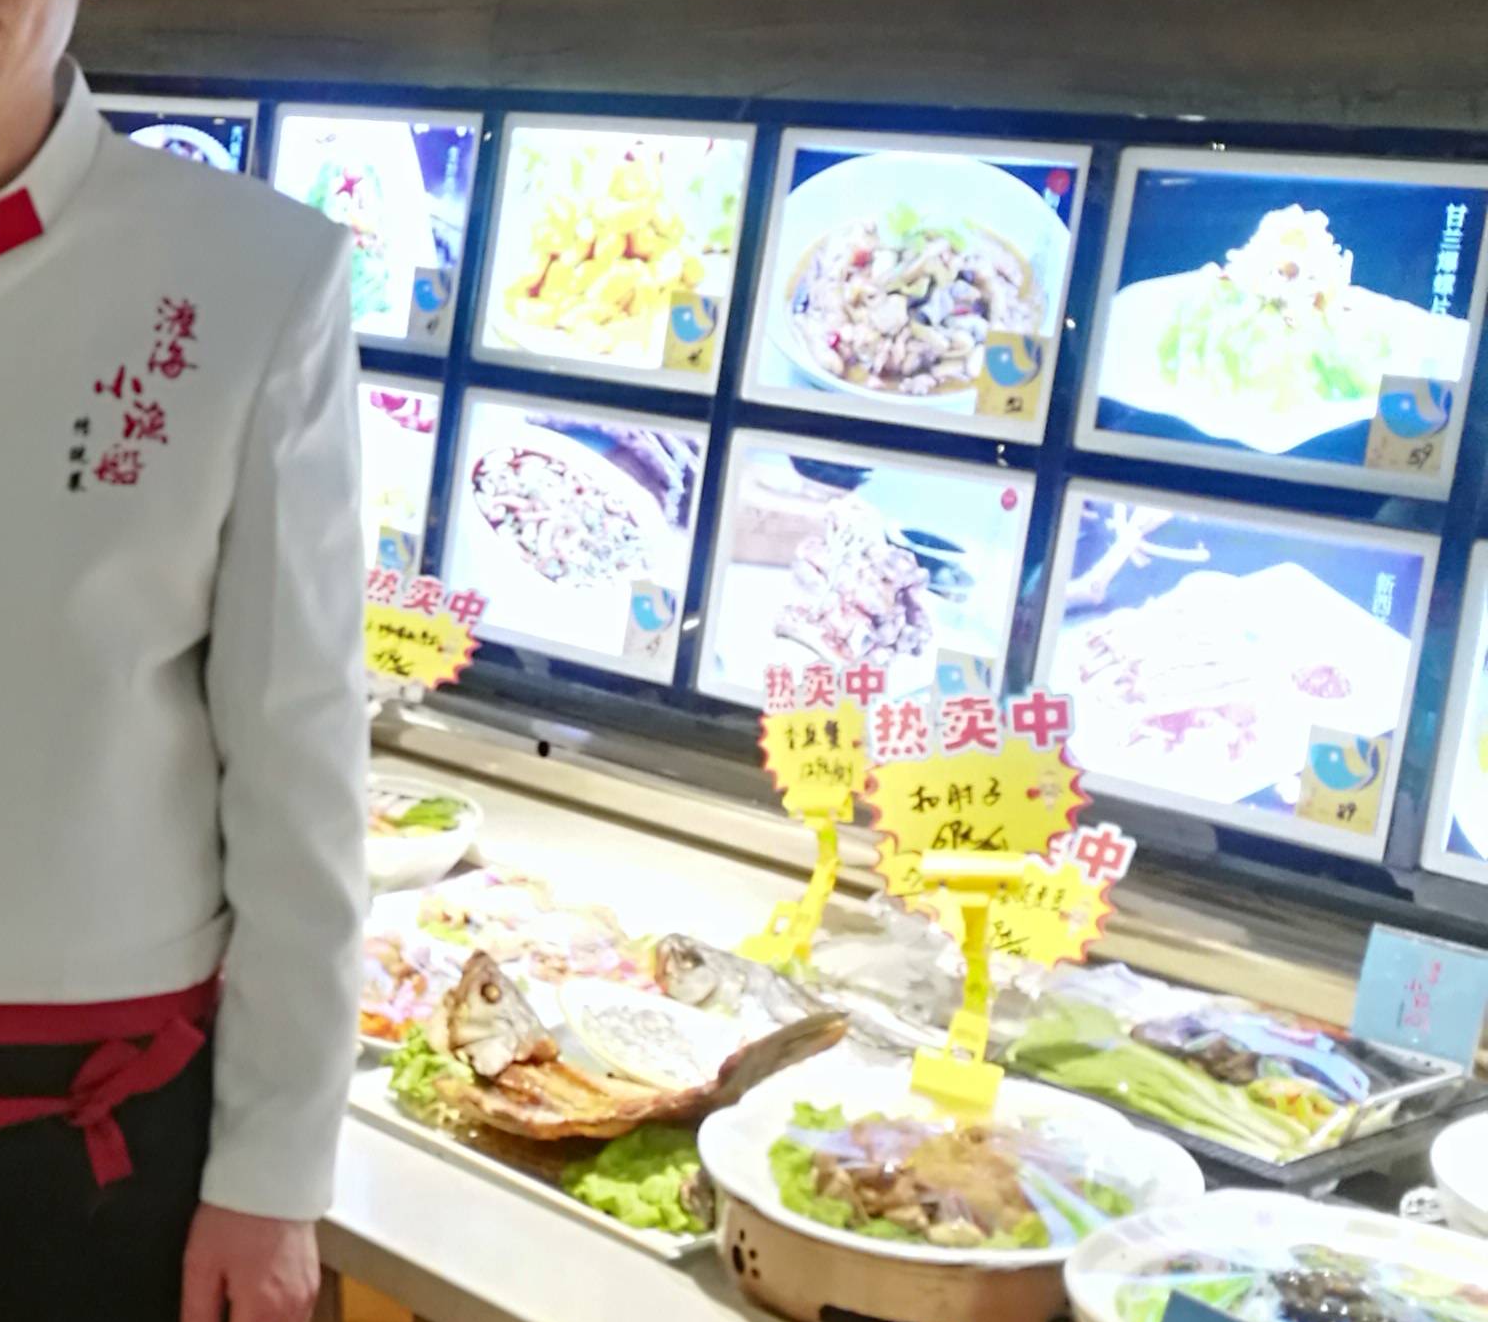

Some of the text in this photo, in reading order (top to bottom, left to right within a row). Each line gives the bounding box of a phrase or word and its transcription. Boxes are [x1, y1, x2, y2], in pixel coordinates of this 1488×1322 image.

[367, 568, 487, 624] 热卖中
[764, 662, 886, 710] 热卖中
[874, 690, 1069, 757] 热卖中
